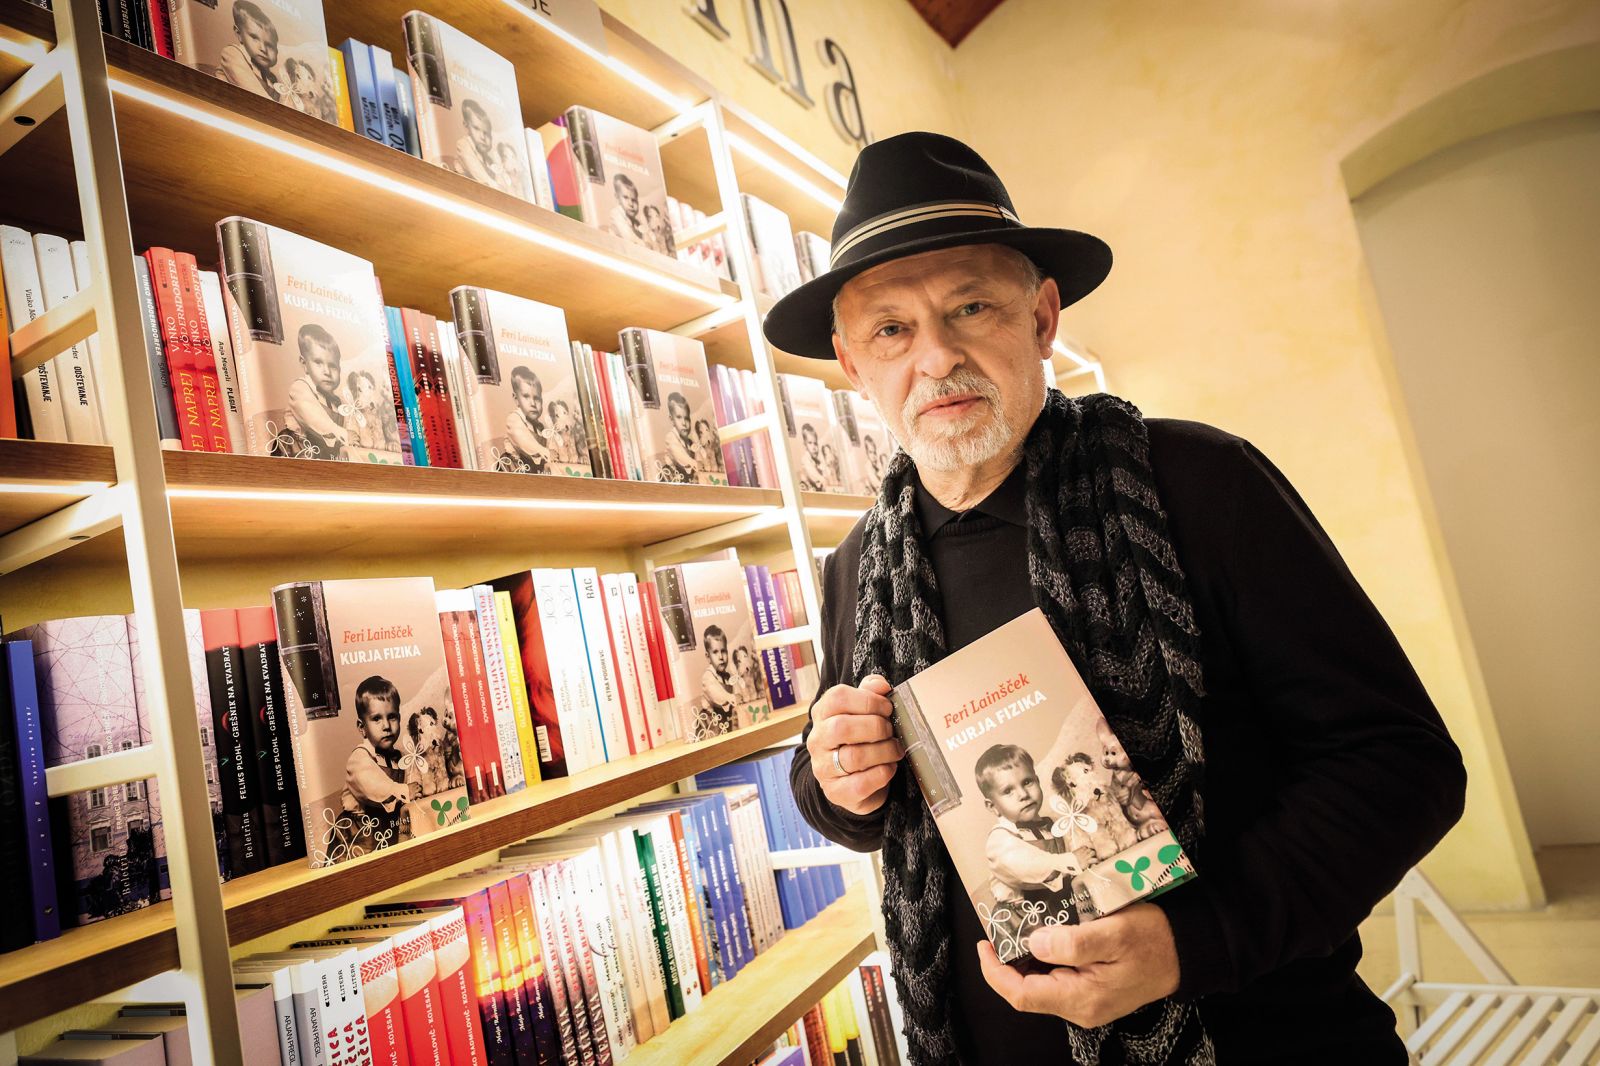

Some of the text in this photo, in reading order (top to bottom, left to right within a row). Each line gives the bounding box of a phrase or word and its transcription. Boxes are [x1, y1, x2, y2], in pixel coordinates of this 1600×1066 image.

[286, 274, 308, 292] Feri
[166, 316, 180, 353] VINKO
[189, 319, 203, 356] VINKO
[180, 369, 201, 427] NAPREJ
[203, 374, 223, 428] NAPREJ
[583, 578, 595, 599] RAC
[693, 604, 737, 619] KURJA FIZIKA
[343, 623, 415, 645] Feri Lainšček
[339, 643, 422, 666] KURJA FIZIKA
[286, 681, 297, 708] FIZIKA
[943, 672, 1031, 729] Feri Lainšček
[291, 708, 301, 736] KURJA
[945, 689, 1048, 752] KURJA FIZIKA
[221, 646, 254, 858] Beletrina FELIKS PLOHL GREŠNIK NA KVADRAT
[257, 642, 292, 848] Beletrina FELIKS PLOHL GREŠNIK NA KVADRAT
[321, 974, 330, 1002] LITERA
[668, 959, 679, 985] MOJCA
[423, 987, 434, 1024] KOLESAR
[458, 969, 476, 1056] RADMILOVIČ KOLESAR
[284, 1015, 297, 1065] ARJAN PREGL
[310, 1007, 321, 1058] ARJAN PREGL
[384, 1007, 395, 1046] KOLESAR
